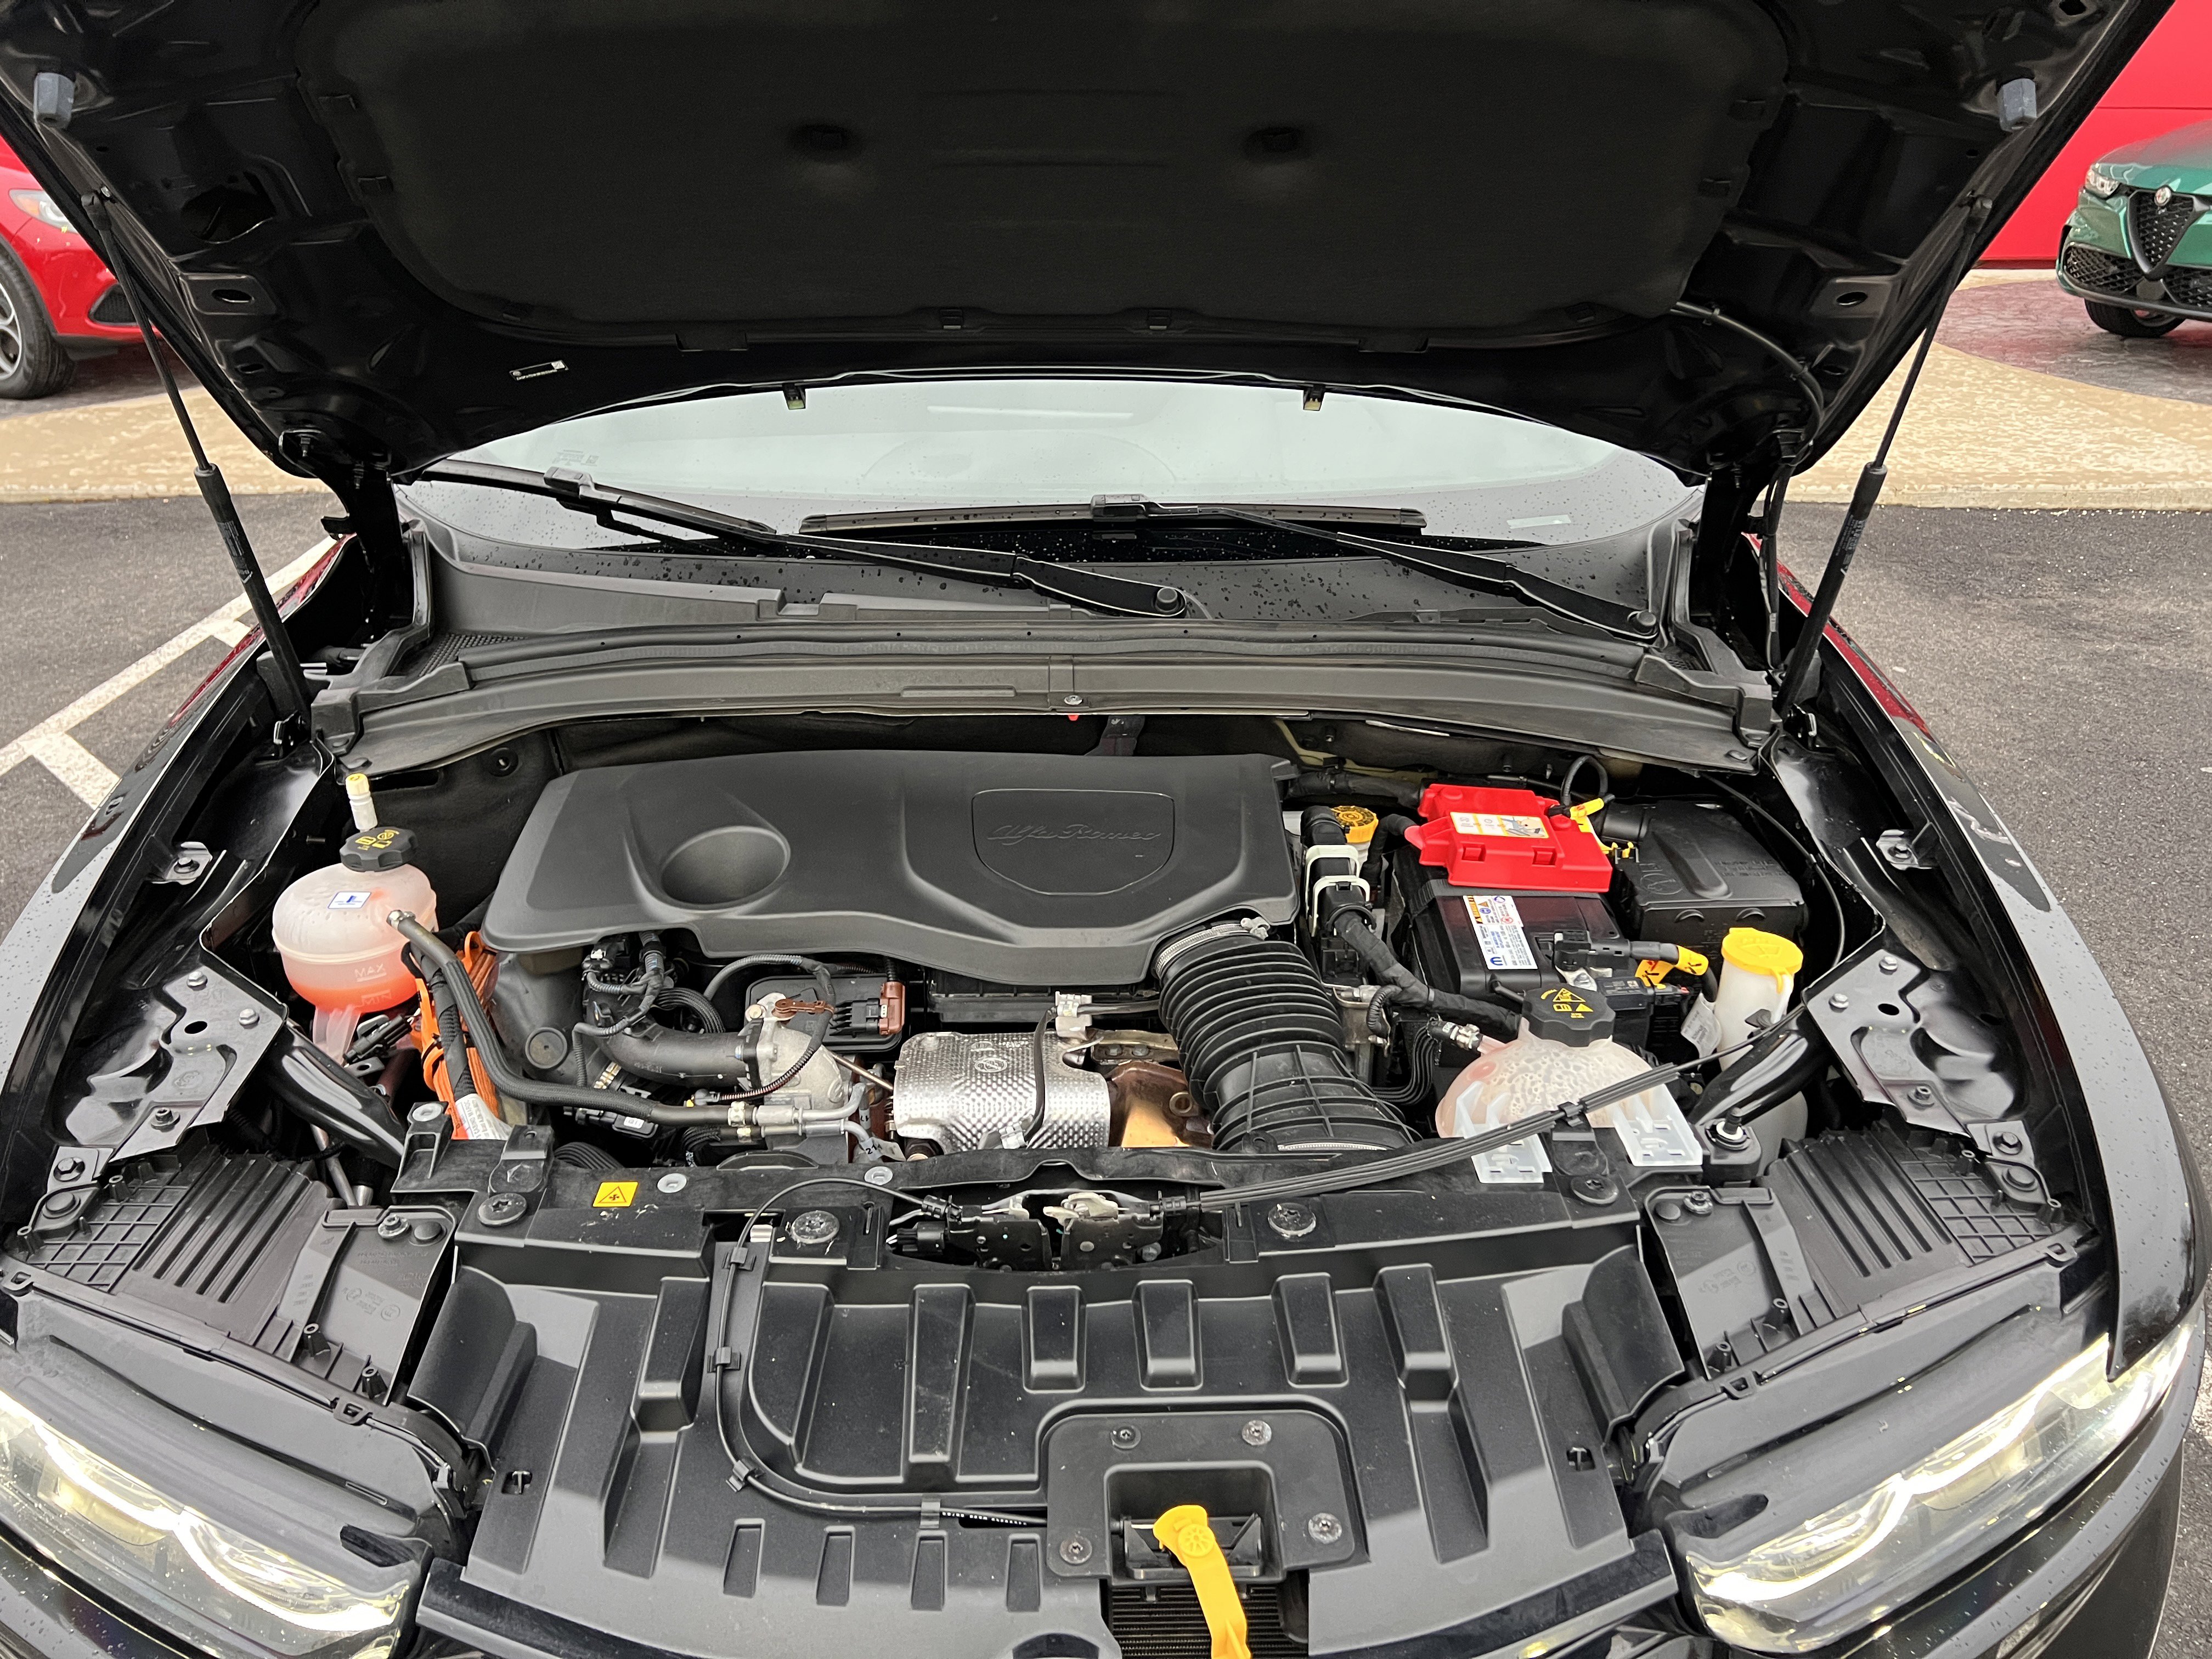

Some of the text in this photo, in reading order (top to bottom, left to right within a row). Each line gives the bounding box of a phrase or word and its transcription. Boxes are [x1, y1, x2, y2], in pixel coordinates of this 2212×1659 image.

[987, 824, 1161, 845] Alfa Romeo
[354, 963, 386, 978] MAX
[361, 992, 392, 1006] MIN
